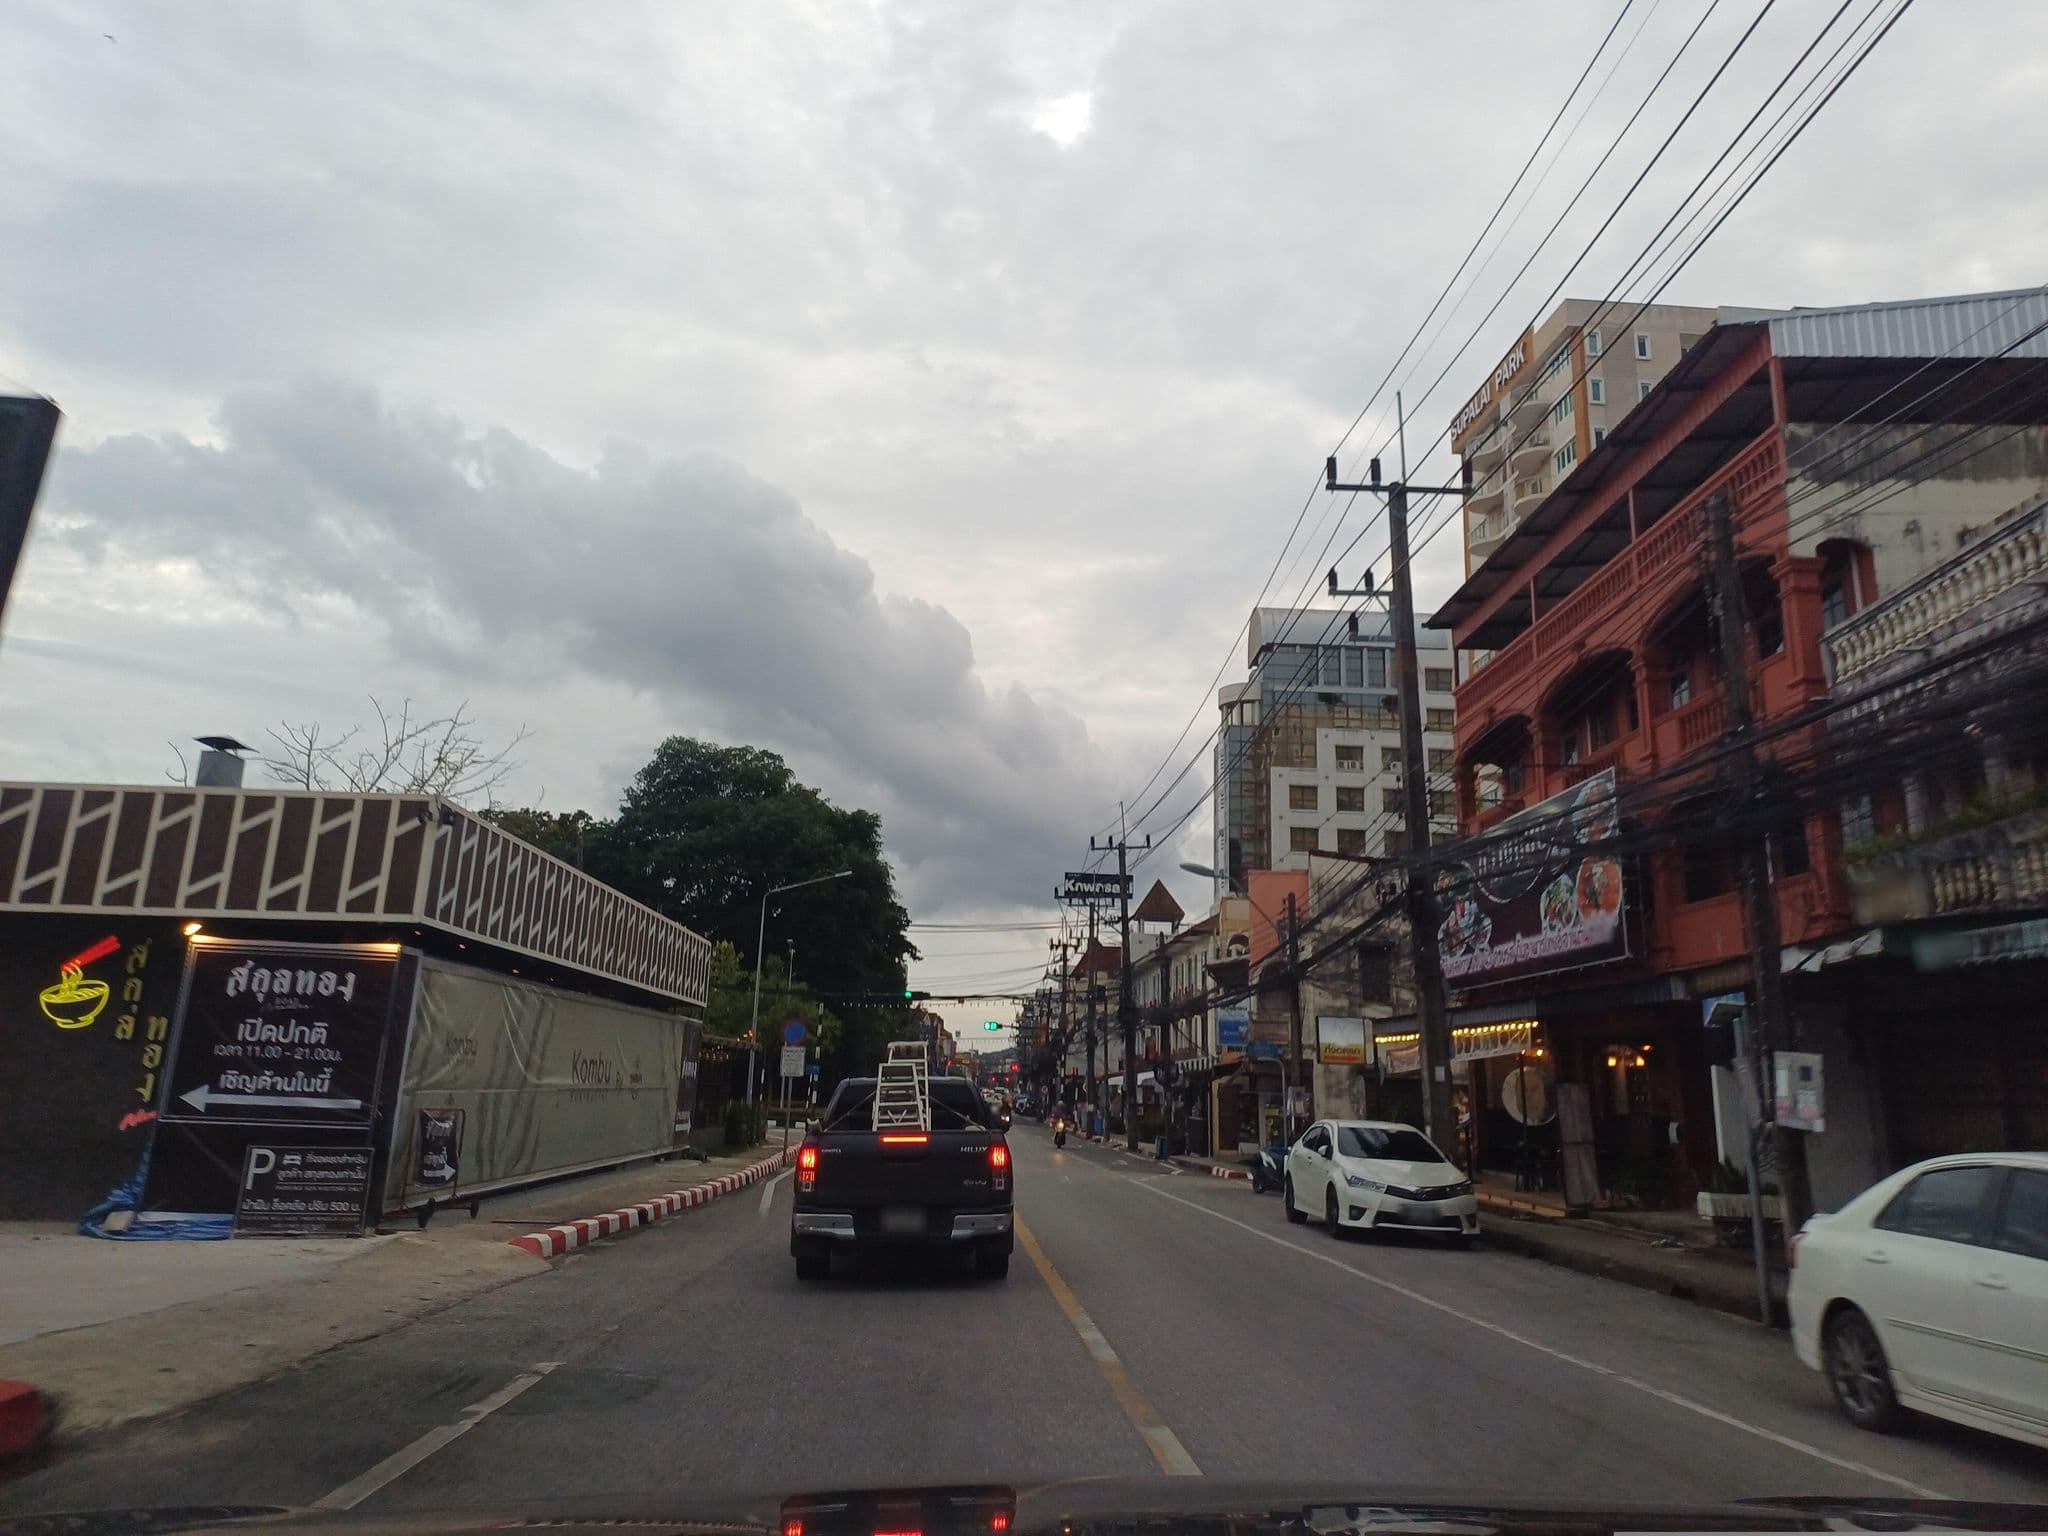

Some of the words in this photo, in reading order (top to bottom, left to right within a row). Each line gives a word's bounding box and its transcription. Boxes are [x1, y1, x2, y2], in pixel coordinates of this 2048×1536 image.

[1451, 383, 1491, 440] SUPALAI
[1495, 342, 1525, 391] PARK
[1065, 879, 1133, 894] Kawasai
[237, 1017, 329, 1045] เปิดปกติ
[571, 1048, 612, 1085] Kombu
[245, 1148, 276, 1190] P
